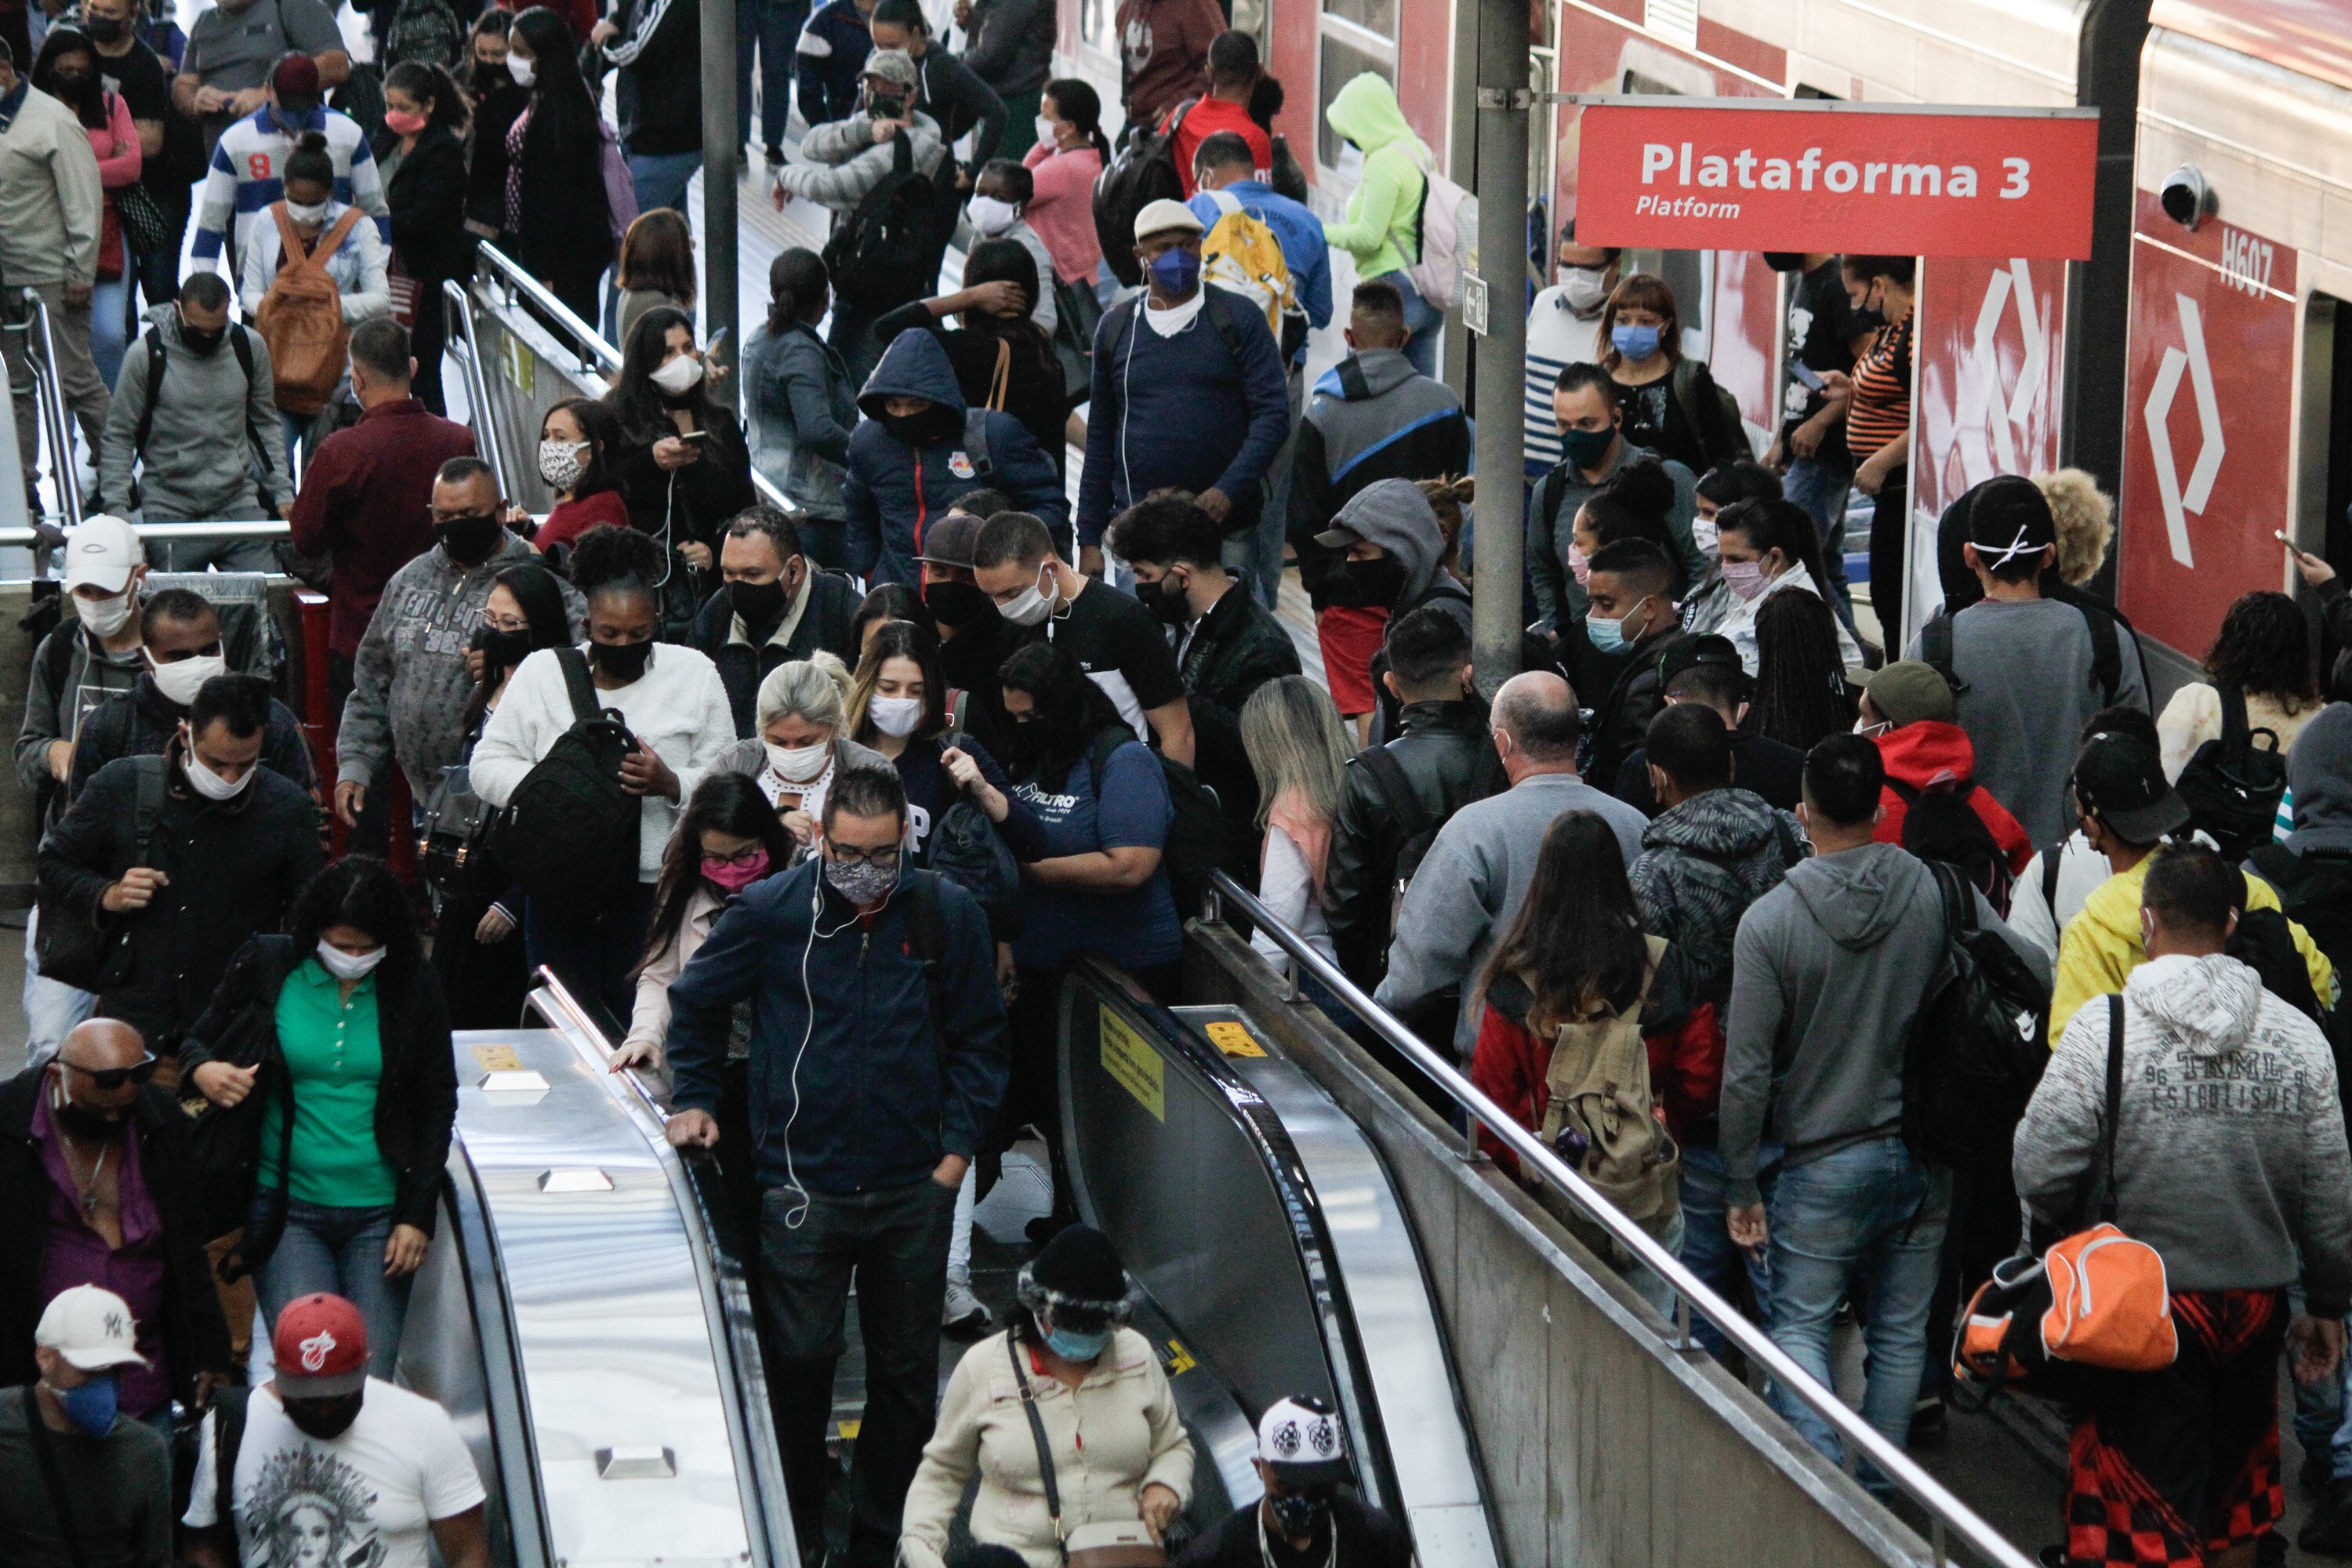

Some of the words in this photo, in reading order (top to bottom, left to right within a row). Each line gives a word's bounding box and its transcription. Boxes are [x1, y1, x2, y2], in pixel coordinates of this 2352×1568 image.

[1642, 142, 1977, 198] Plataforma
[1998, 157, 2031, 200] 3
[1635, 194, 1740, 220] Platform
[2220, 227, 2274, 300] H607
[1031, 791, 1076, 808] FILTRO
[2144, 1065, 2167, 1086] 96
